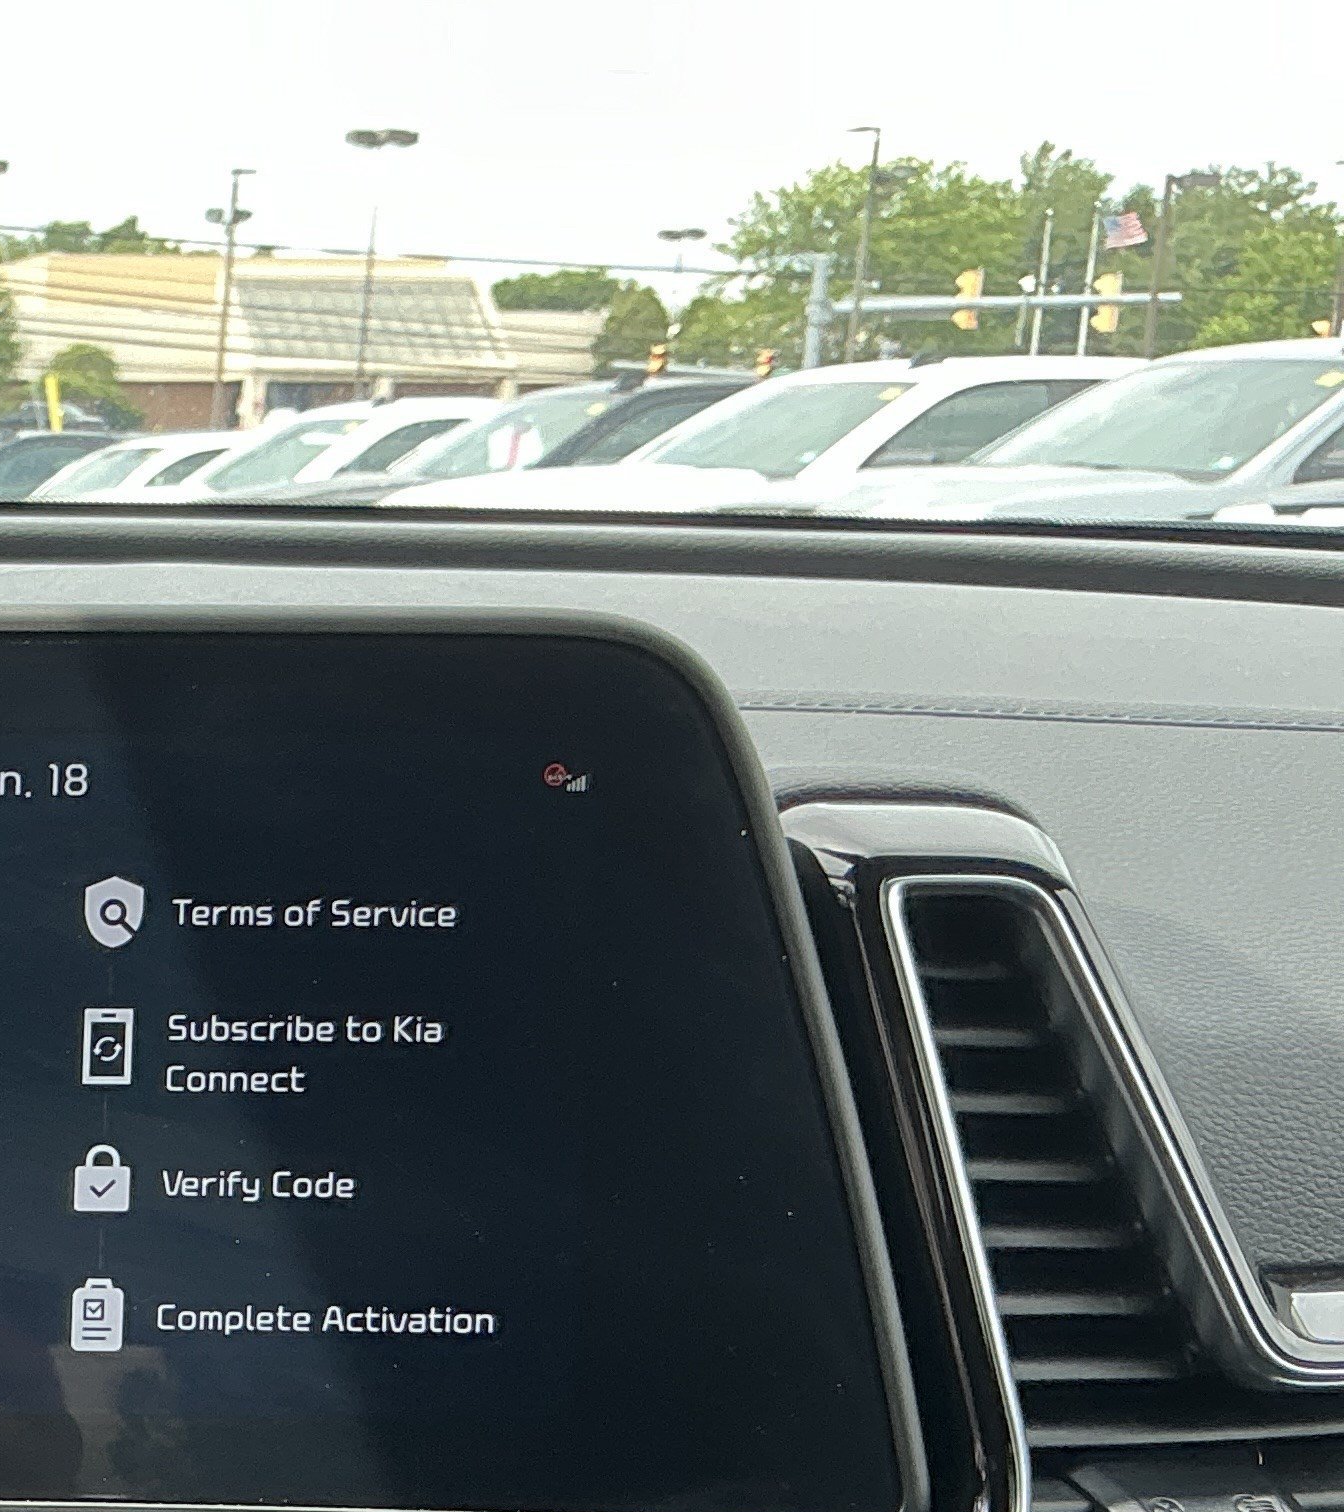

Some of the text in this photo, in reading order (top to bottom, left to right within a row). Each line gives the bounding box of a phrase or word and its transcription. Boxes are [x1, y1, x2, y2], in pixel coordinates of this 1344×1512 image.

[48, 763, 88, 797] 18
[171, 898, 457, 928] Terms of Service
[168, 1014, 444, 1043] Subscribe to Kia
[166, 1064, 306, 1093] Connect
[162, 1170, 355, 1203] Verify Code
[157, 1303, 495, 1336] Complete Activation
